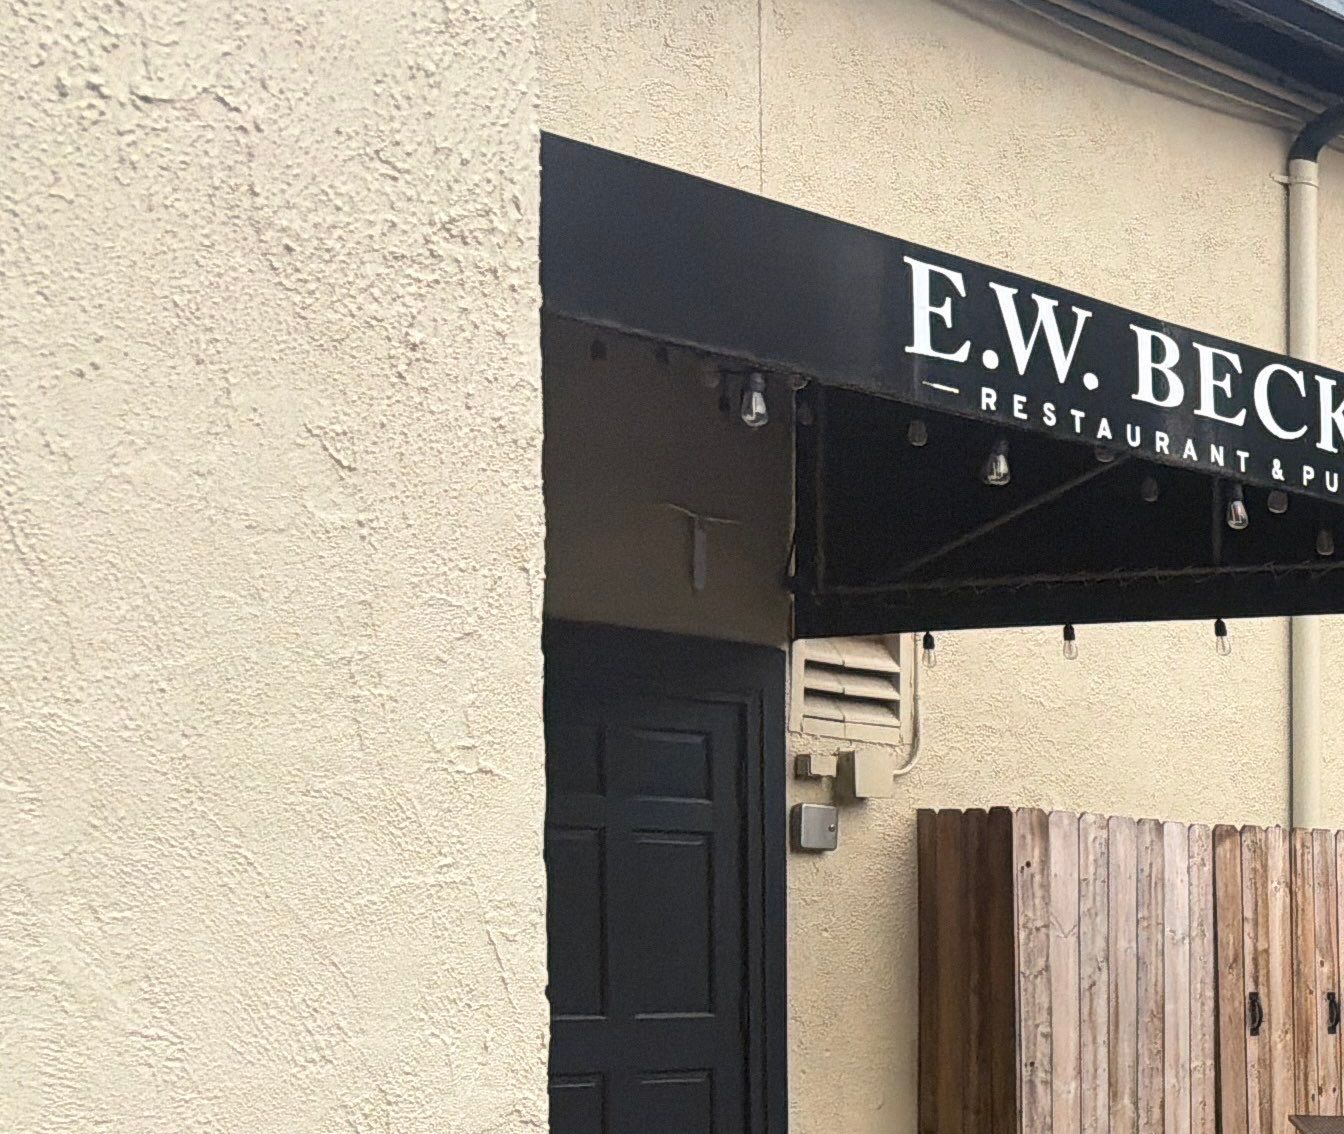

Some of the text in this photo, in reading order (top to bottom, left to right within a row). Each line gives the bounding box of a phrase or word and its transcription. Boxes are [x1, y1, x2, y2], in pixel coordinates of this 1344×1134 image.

[903, 256, 1099, 390] E.W.
[980, 387, 1250, 472] RESTAURANT
[1271, 458, 1285, 481] &
